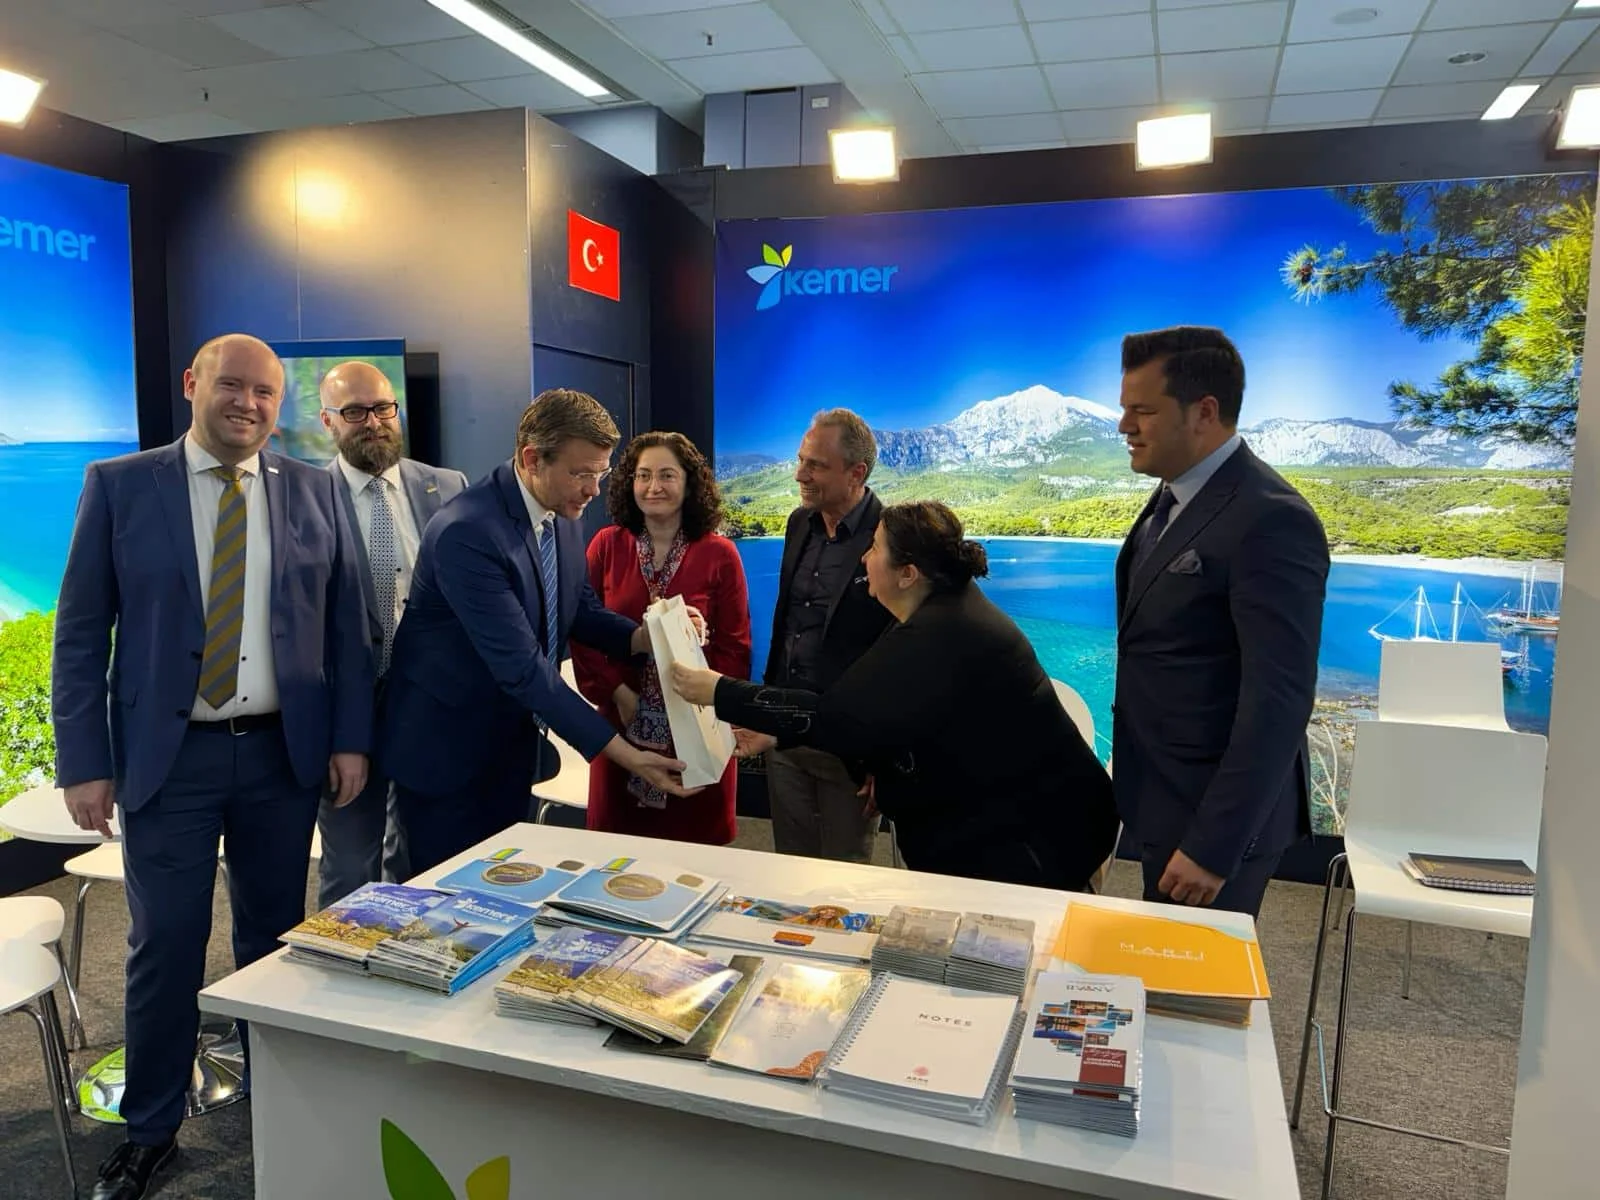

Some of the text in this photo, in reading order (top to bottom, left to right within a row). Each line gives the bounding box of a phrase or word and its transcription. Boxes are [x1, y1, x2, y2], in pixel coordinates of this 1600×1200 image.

[0, 216, 96, 262] emer
[784, 265, 899, 296] kemer
[465, 902, 508, 921] kemer
[919, 1013, 972, 1027] NOTES
